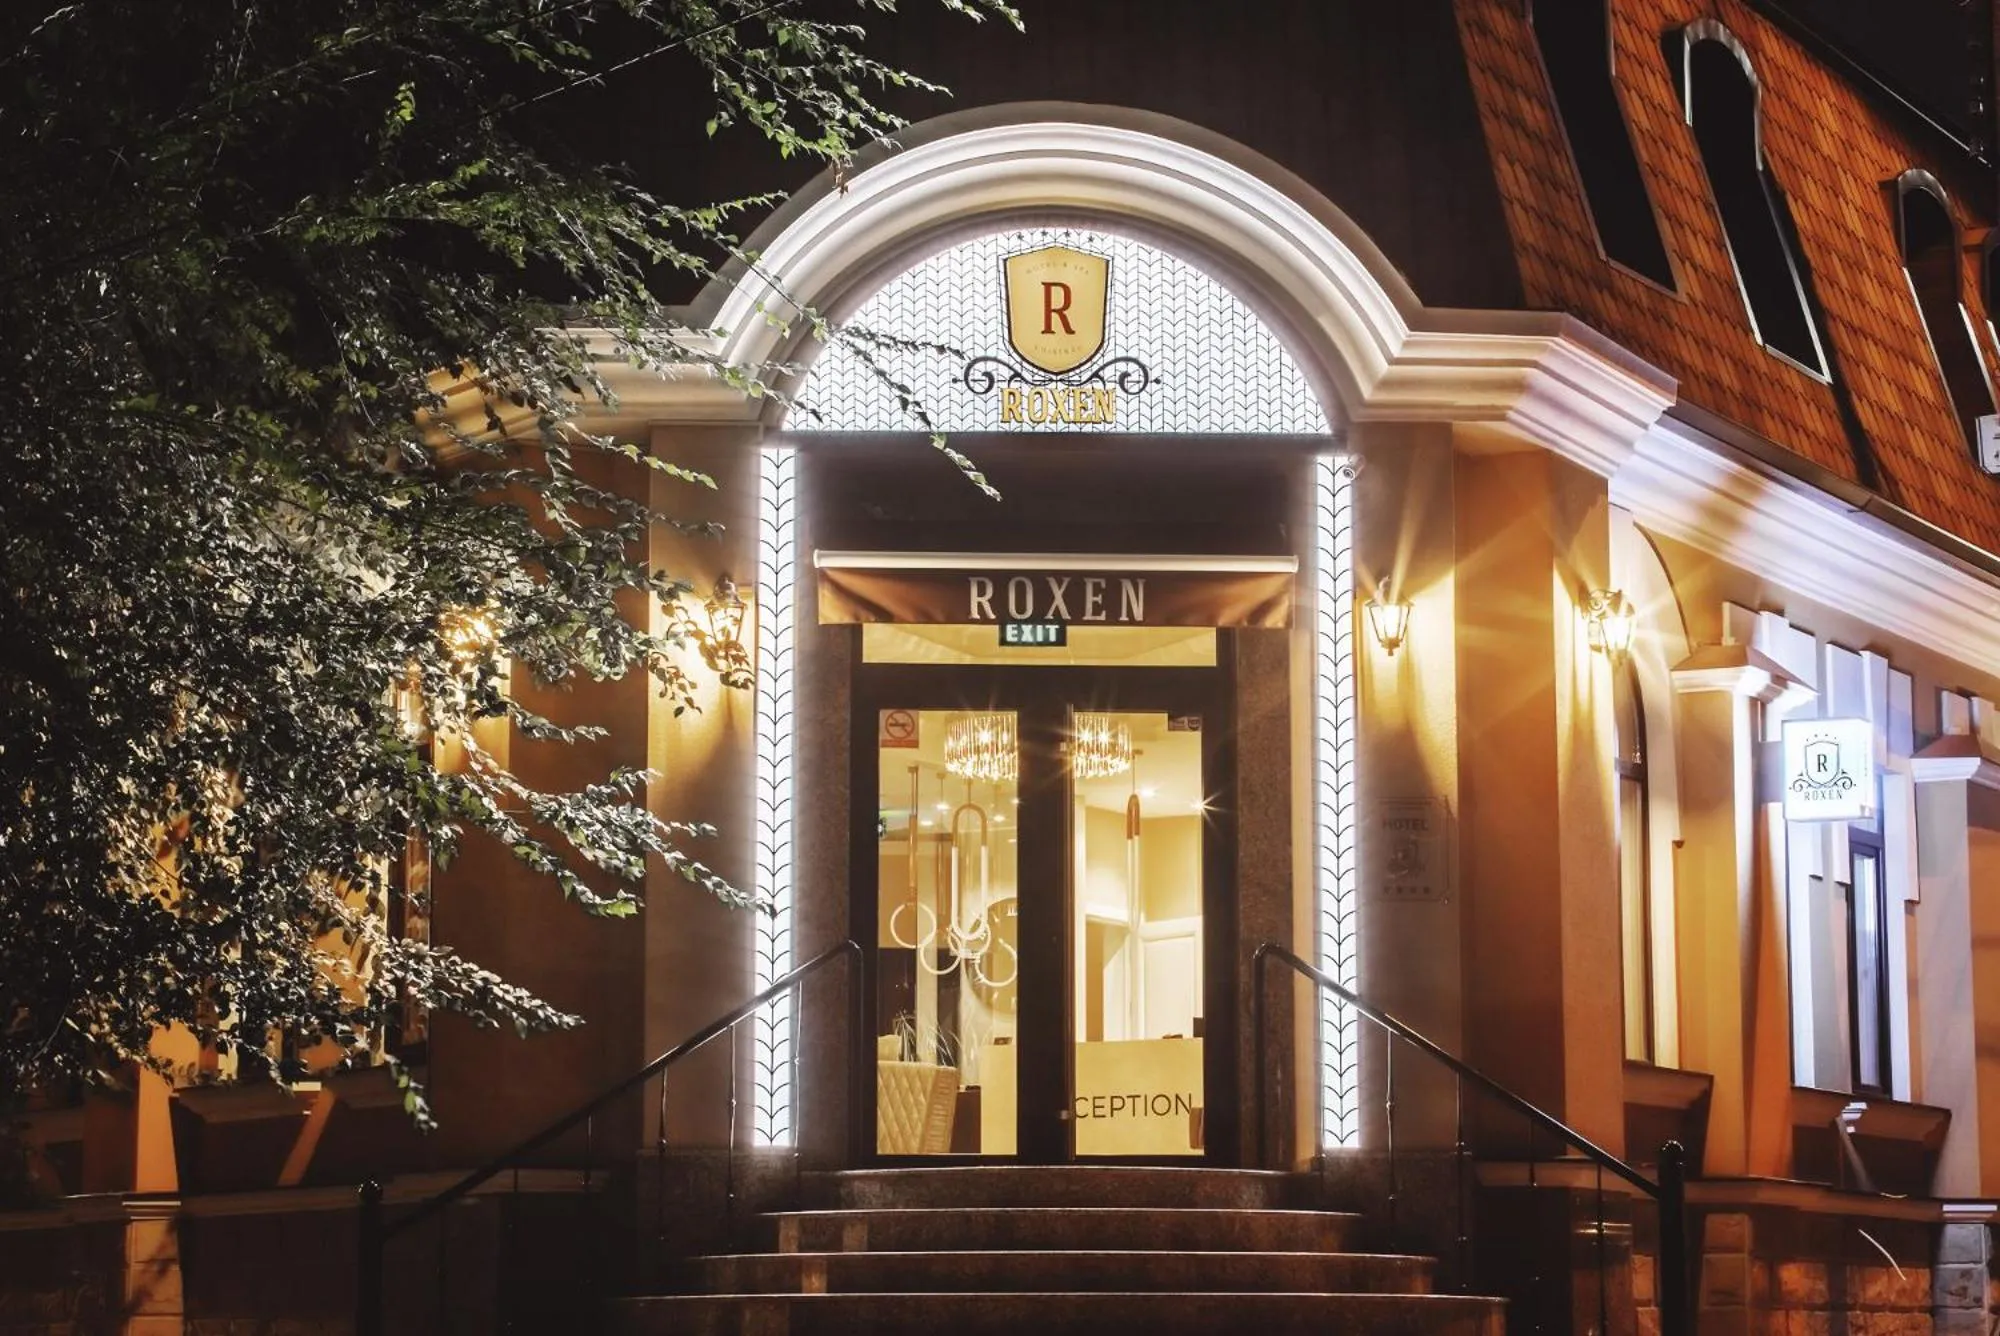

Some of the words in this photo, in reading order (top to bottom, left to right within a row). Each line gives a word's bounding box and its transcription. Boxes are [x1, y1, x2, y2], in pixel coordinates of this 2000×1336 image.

[1041, 281, 1076, 335] R
[1000, 387, 1116, 424] ROXEN
[968, 576, 1147, 622] ROXEN
[1006, 624, 1059, 642] EXIT
[1817, 754, 1828, 773] R
[1804, 790, 1843, 801] ROXEN
[1075, 1093, 1192, 1119] CEPTION
